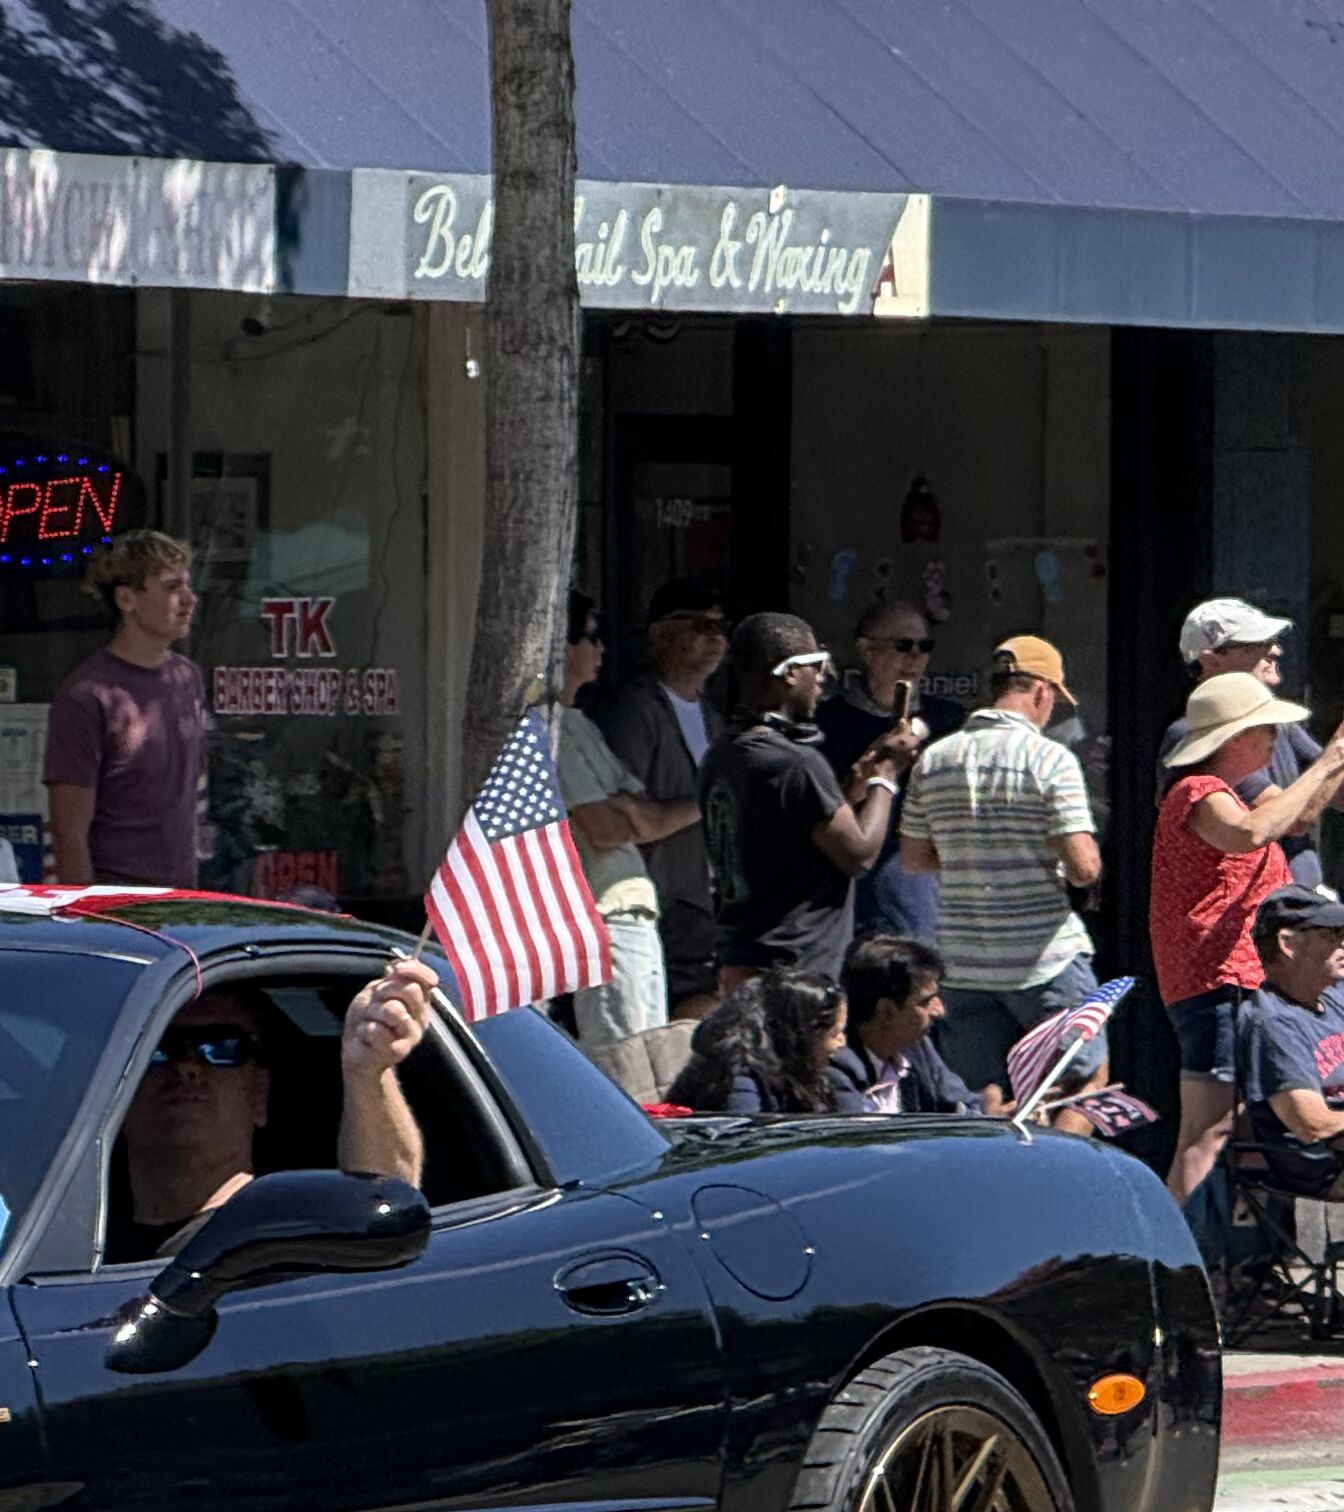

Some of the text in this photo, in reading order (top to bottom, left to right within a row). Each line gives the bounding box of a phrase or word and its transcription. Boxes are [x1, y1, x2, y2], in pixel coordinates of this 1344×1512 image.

[574, 198, 627, 287] ail
[632, 206, 699, 304] Spa
[709, 201, 742, 290] &
[746, 208, 874, 313] Waxing
[261, 596, 338, 658] TK
[213, 666, 288, 714] BARBER
[290, 667, 342, 716] SHOP
[363, 668, 399, 715] SPA
[919, 672, 978, 695] aniel
